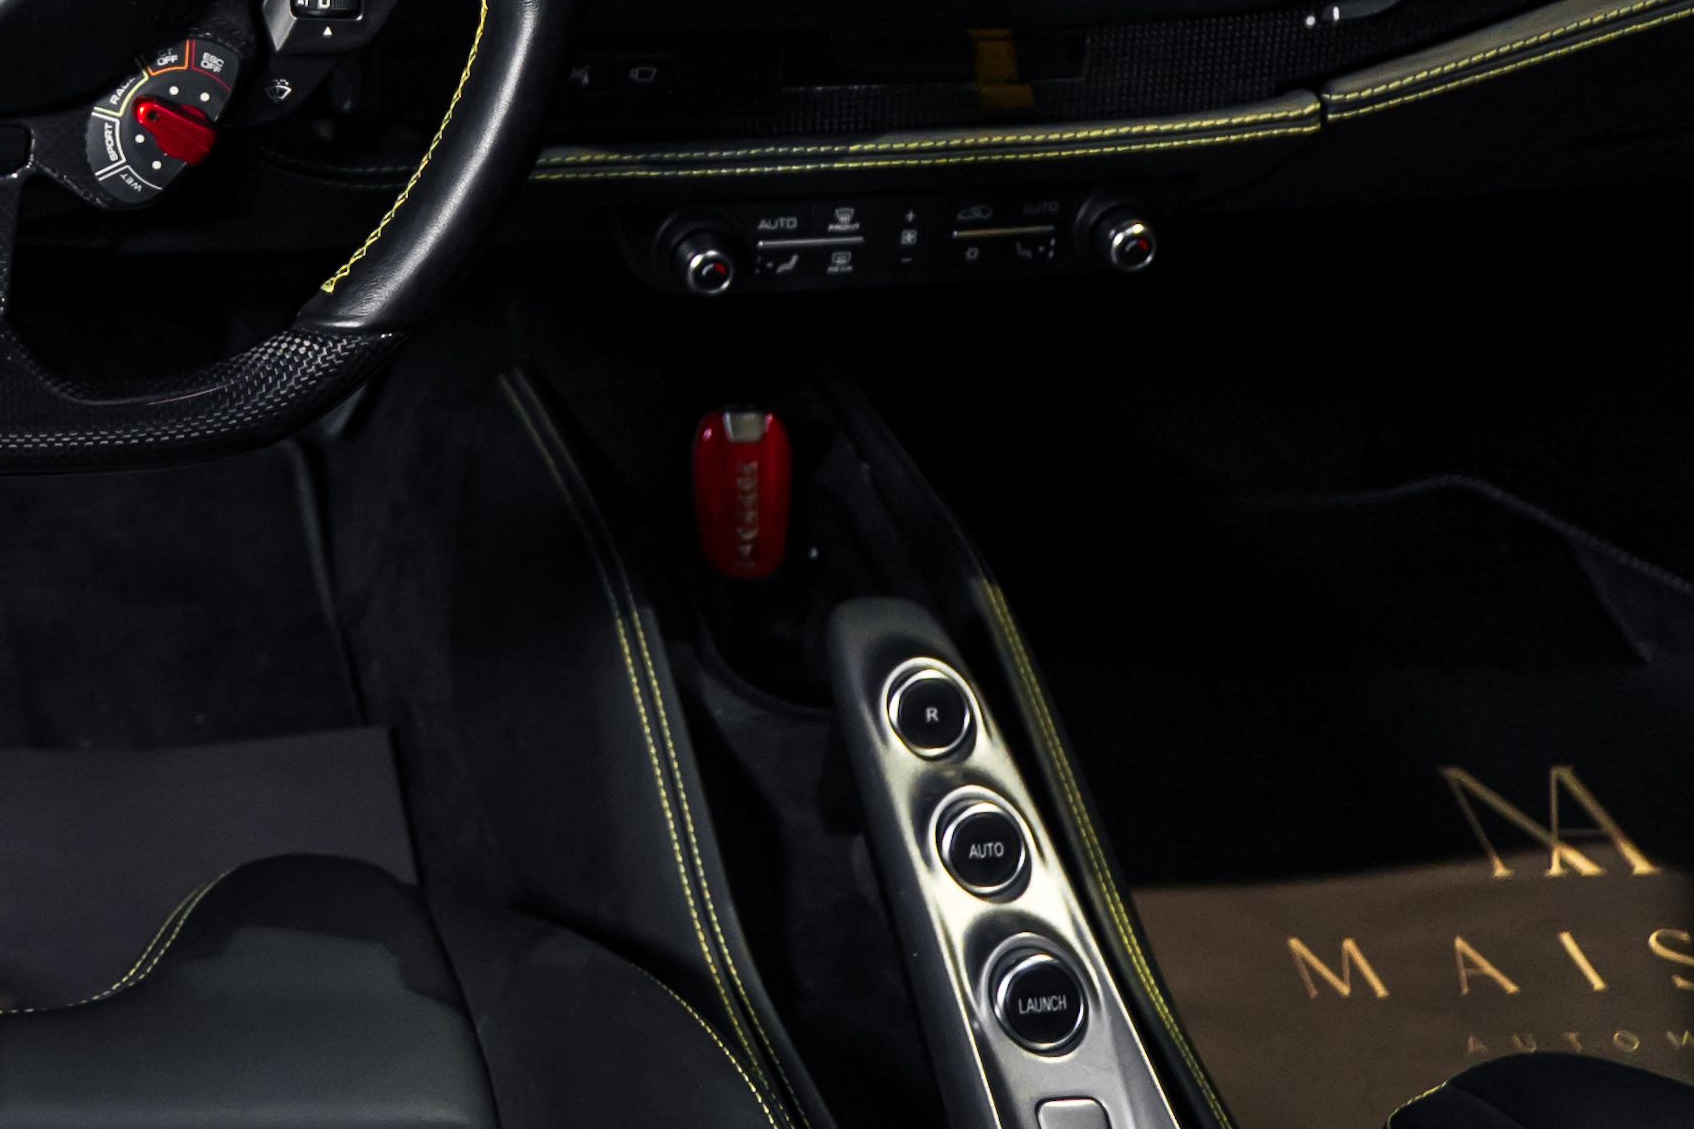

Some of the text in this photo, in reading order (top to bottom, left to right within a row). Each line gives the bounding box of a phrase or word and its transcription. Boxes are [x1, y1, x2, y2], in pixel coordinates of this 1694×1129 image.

[157, 54, 179, 66] OFF
[200, 60, 222, 73] OFF
[202, 52, 225, 67] ESC
[104, 122, 119, 162] SPORT
[120, 173, 143, 193] WET
[758, 216, 798, 229] AUTO
[926, 708, 939, 723] R
[969, 842, 1005, 860] AUTO
[1018, 995, 1068, 1014] LAUNCH
